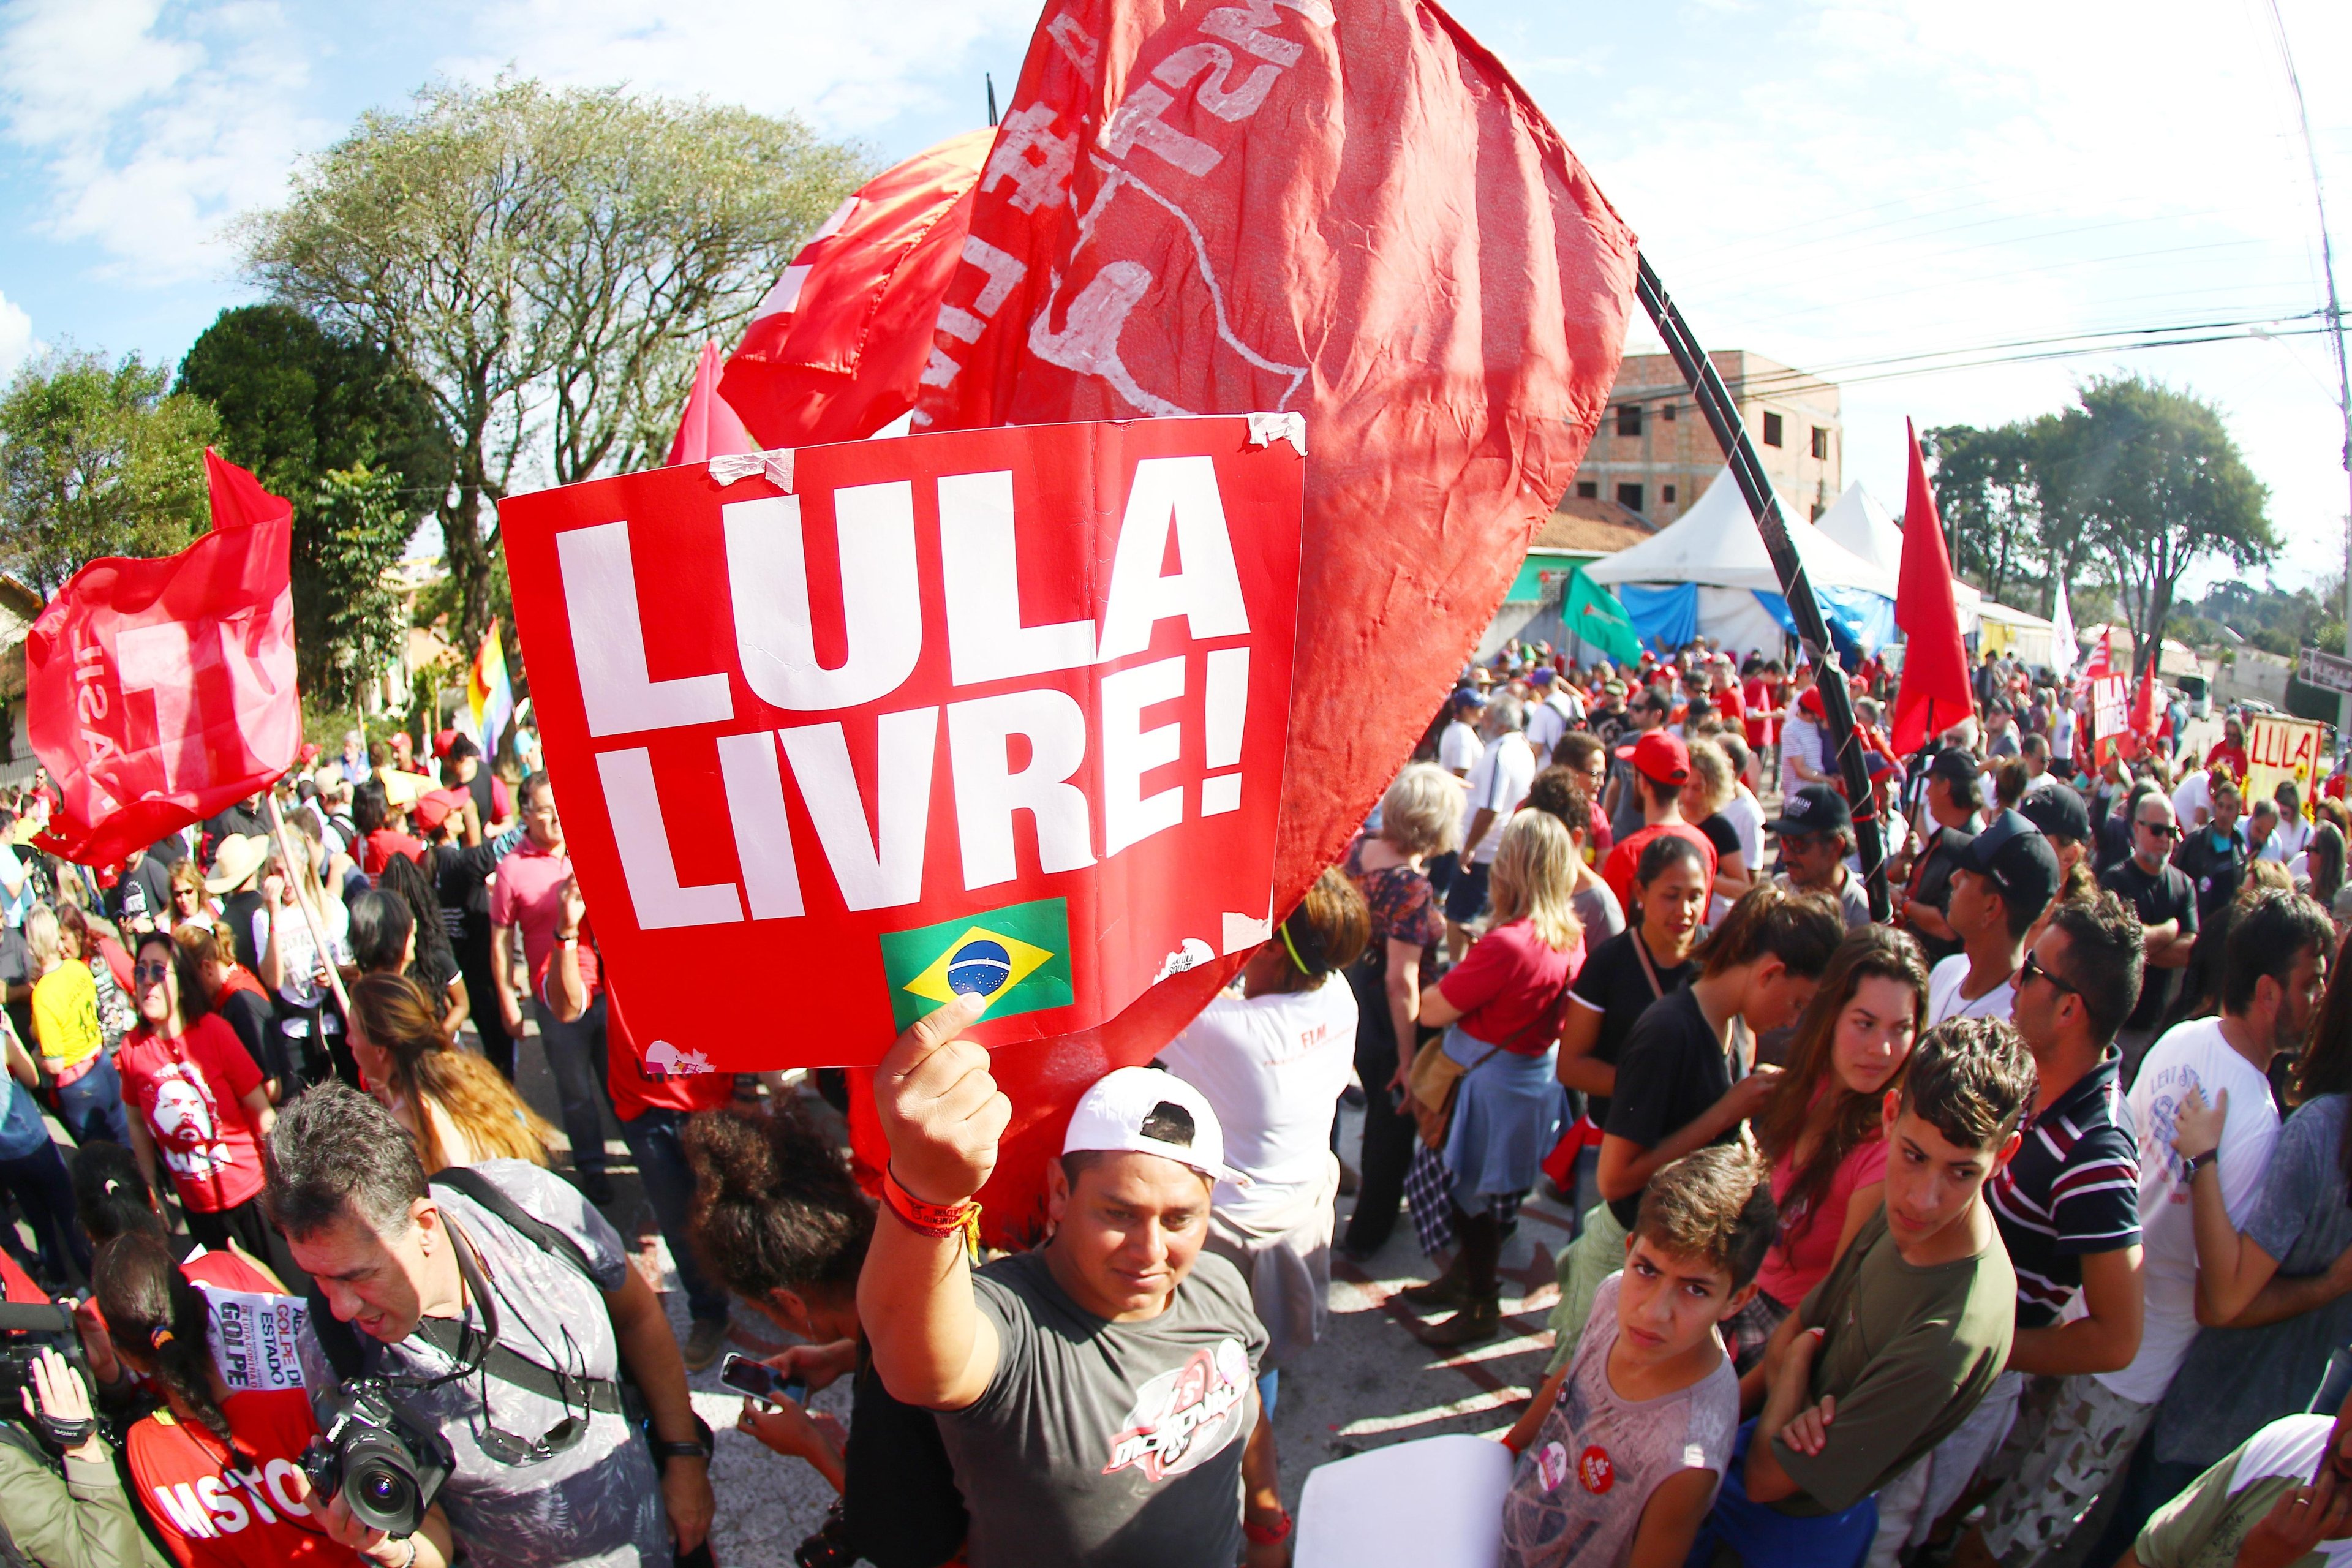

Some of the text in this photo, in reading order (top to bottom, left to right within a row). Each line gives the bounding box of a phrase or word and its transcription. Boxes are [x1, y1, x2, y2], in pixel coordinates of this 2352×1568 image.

[556, 455, 1251, 737] LULA
[2251, 723, 2313, 769] LULA
[595, 646, 1251, 930] LIVRE!
[221, 1302, 249, 1387] GOLPE
[260, 1313, 284, 1385] ESTADO
[277, 1303, 296, 1366] GOLPE
